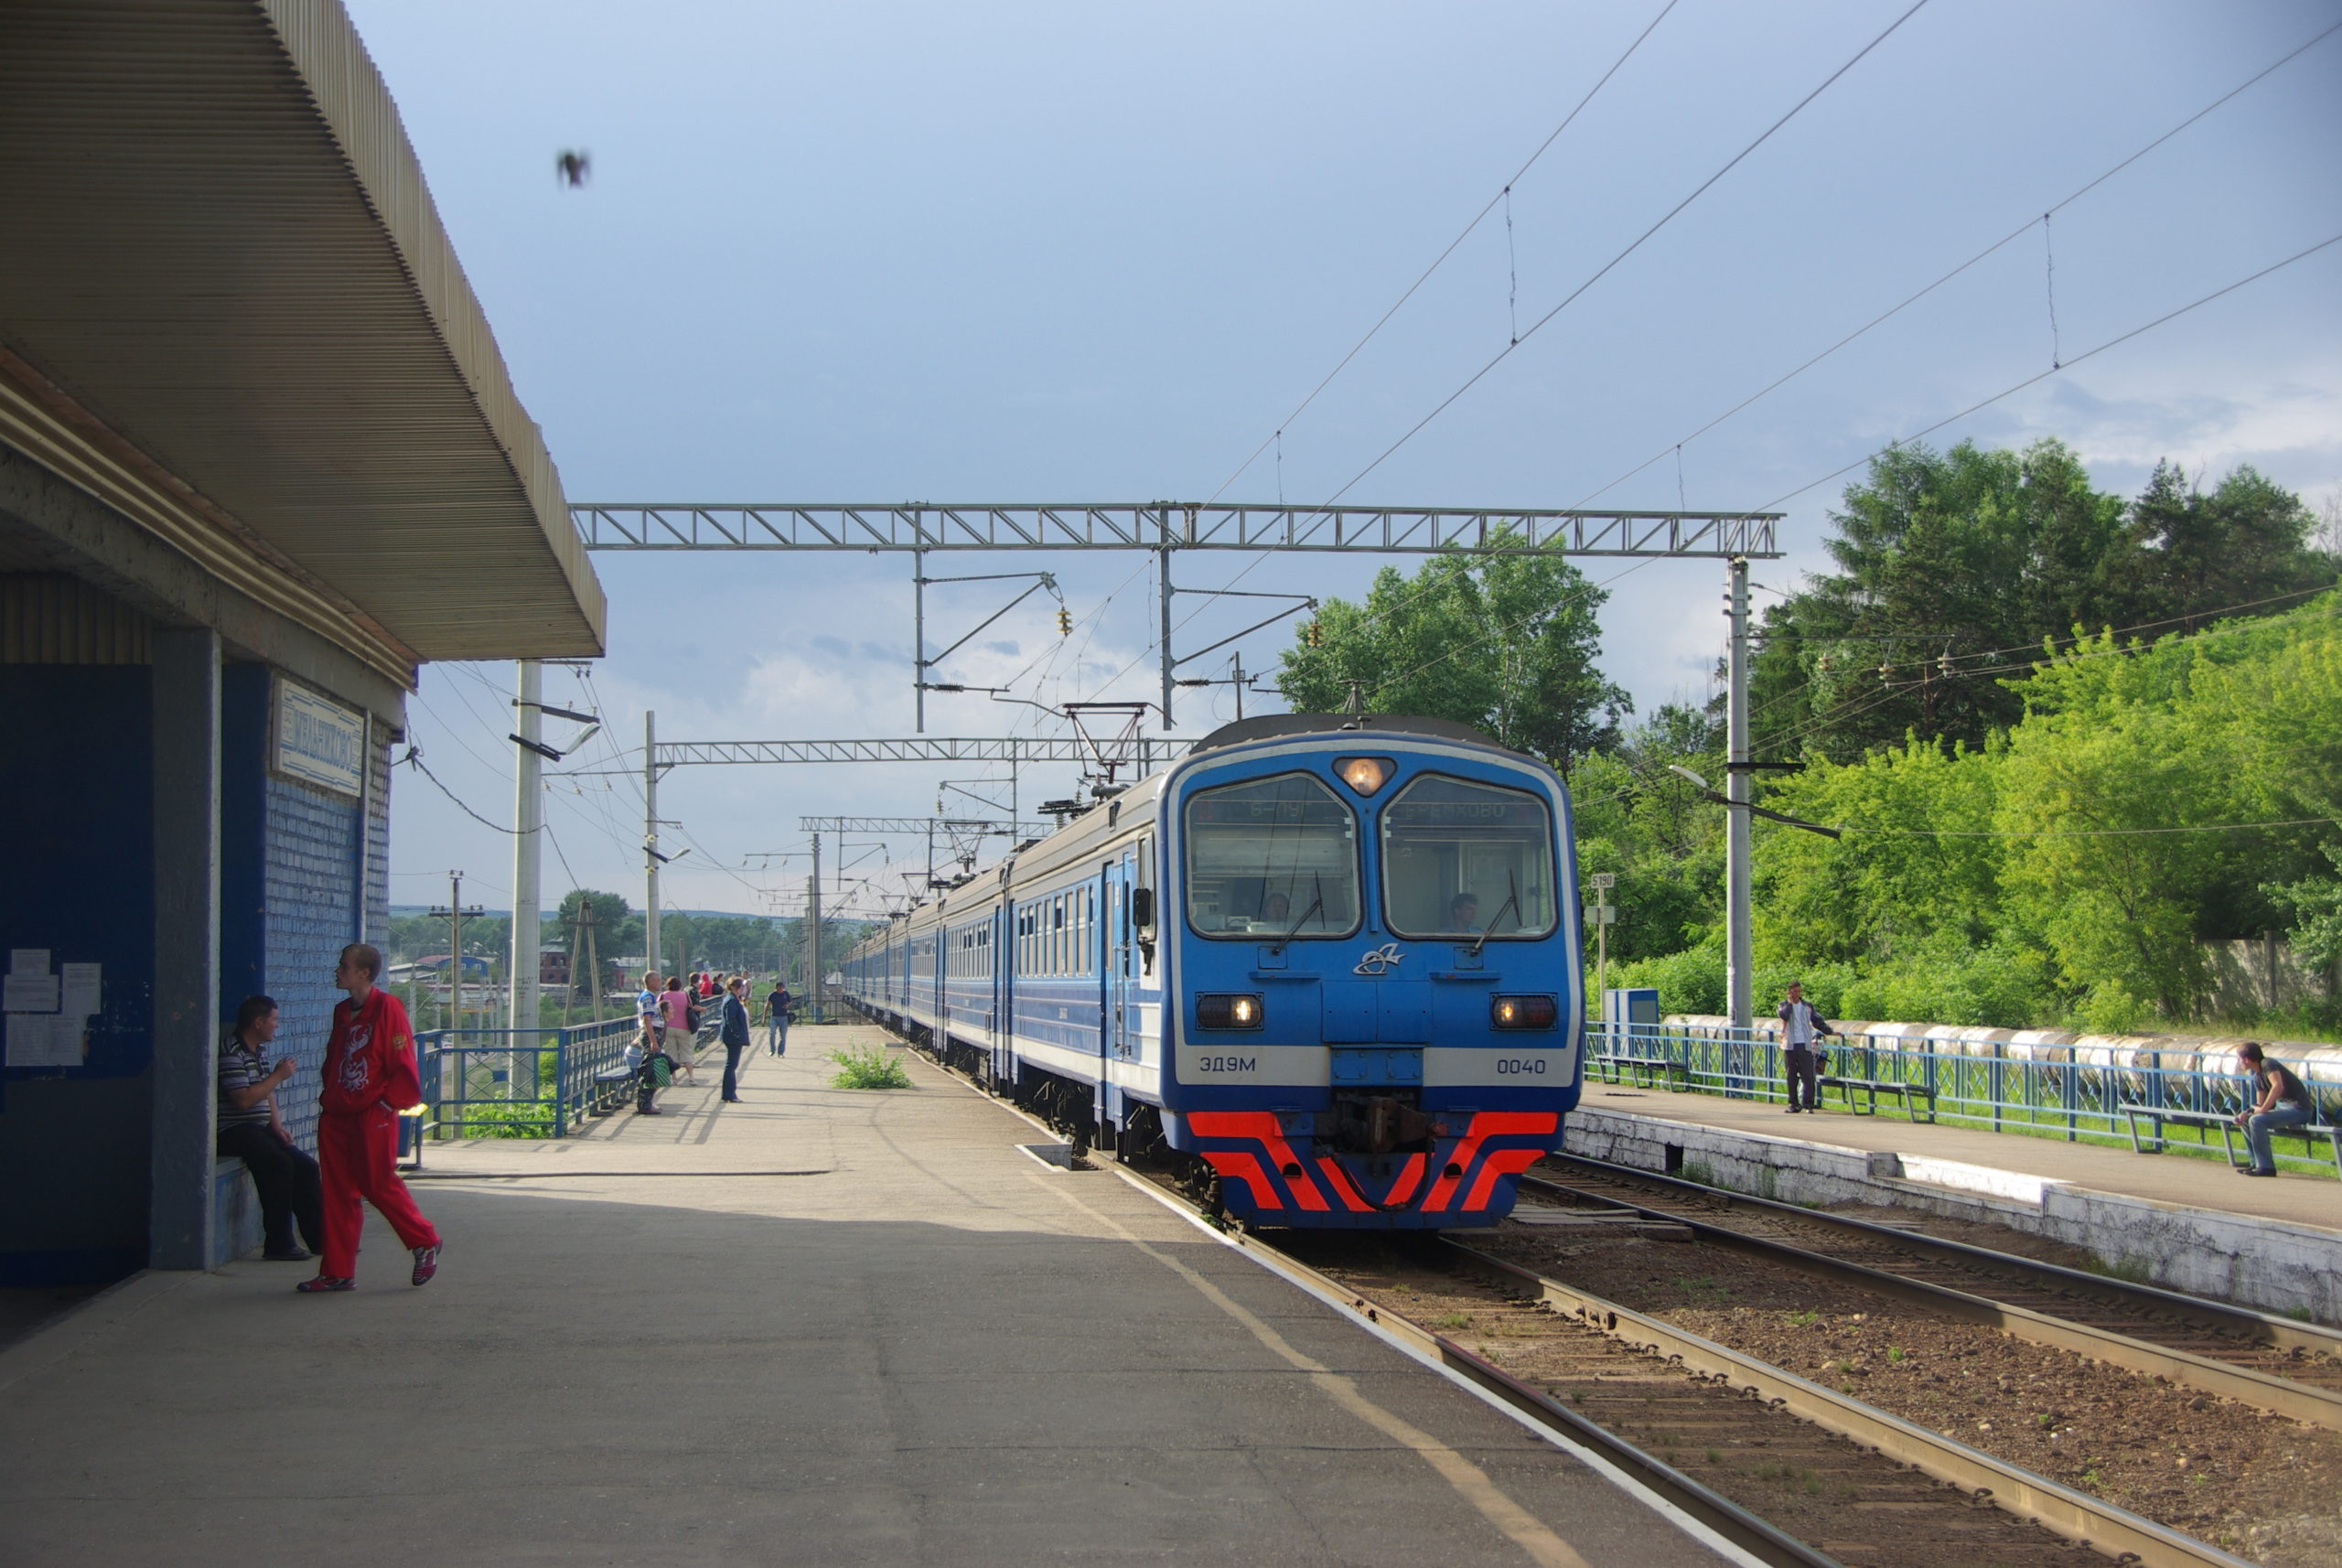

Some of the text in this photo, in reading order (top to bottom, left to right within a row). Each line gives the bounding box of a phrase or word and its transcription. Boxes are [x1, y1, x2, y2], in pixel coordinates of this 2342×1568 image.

[1592, 875, 1612, 886] 5190
[1200, 1057, 1256, 1072] ЭД9М
[1497, 1059, 1546, 1074] 0040
